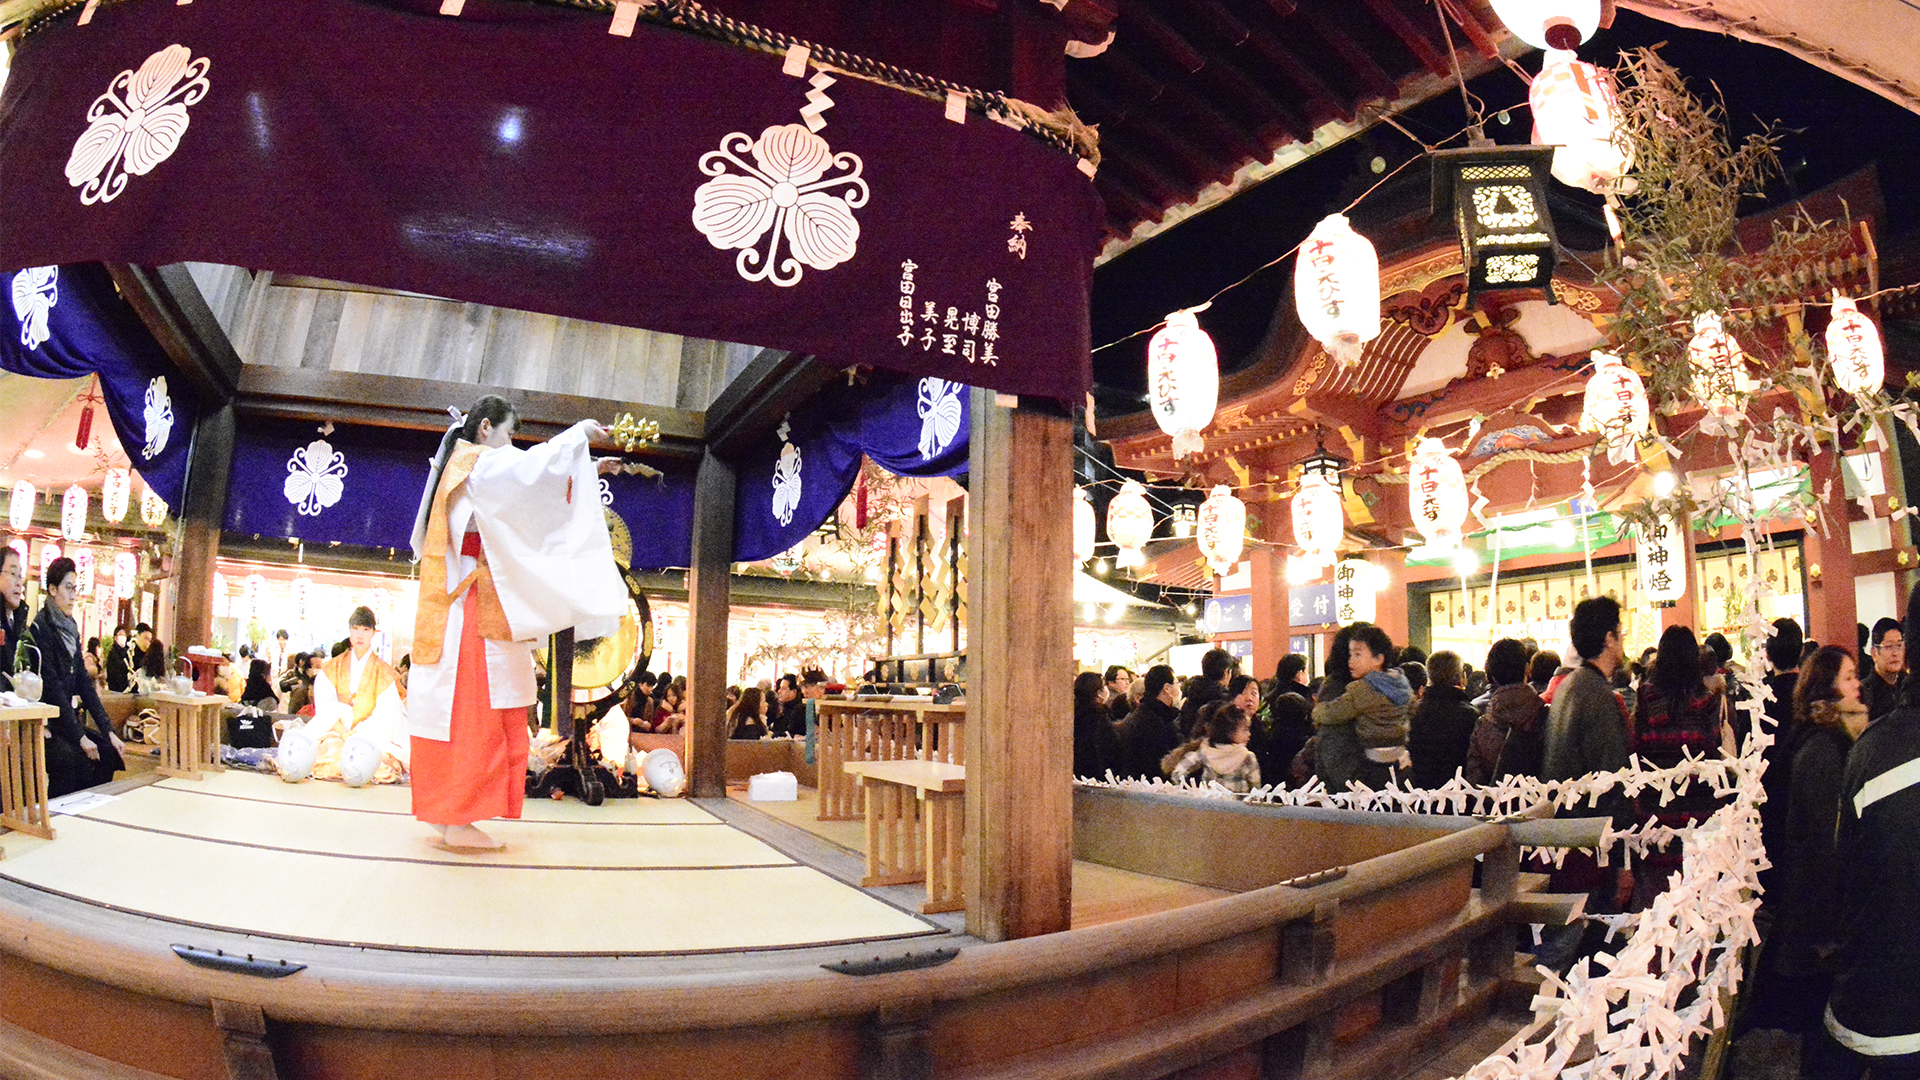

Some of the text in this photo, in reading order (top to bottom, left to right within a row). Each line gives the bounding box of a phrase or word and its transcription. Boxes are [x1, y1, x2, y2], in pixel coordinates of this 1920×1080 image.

[1007, 211, 1033, 260] 奉納
[920, 300, 939, 351] 美子
[961, 311, 981, 363] 博司
[980, 277, 1003, 367] 宮田勝美
[1337, 563, 1355, 621] 御神燈
